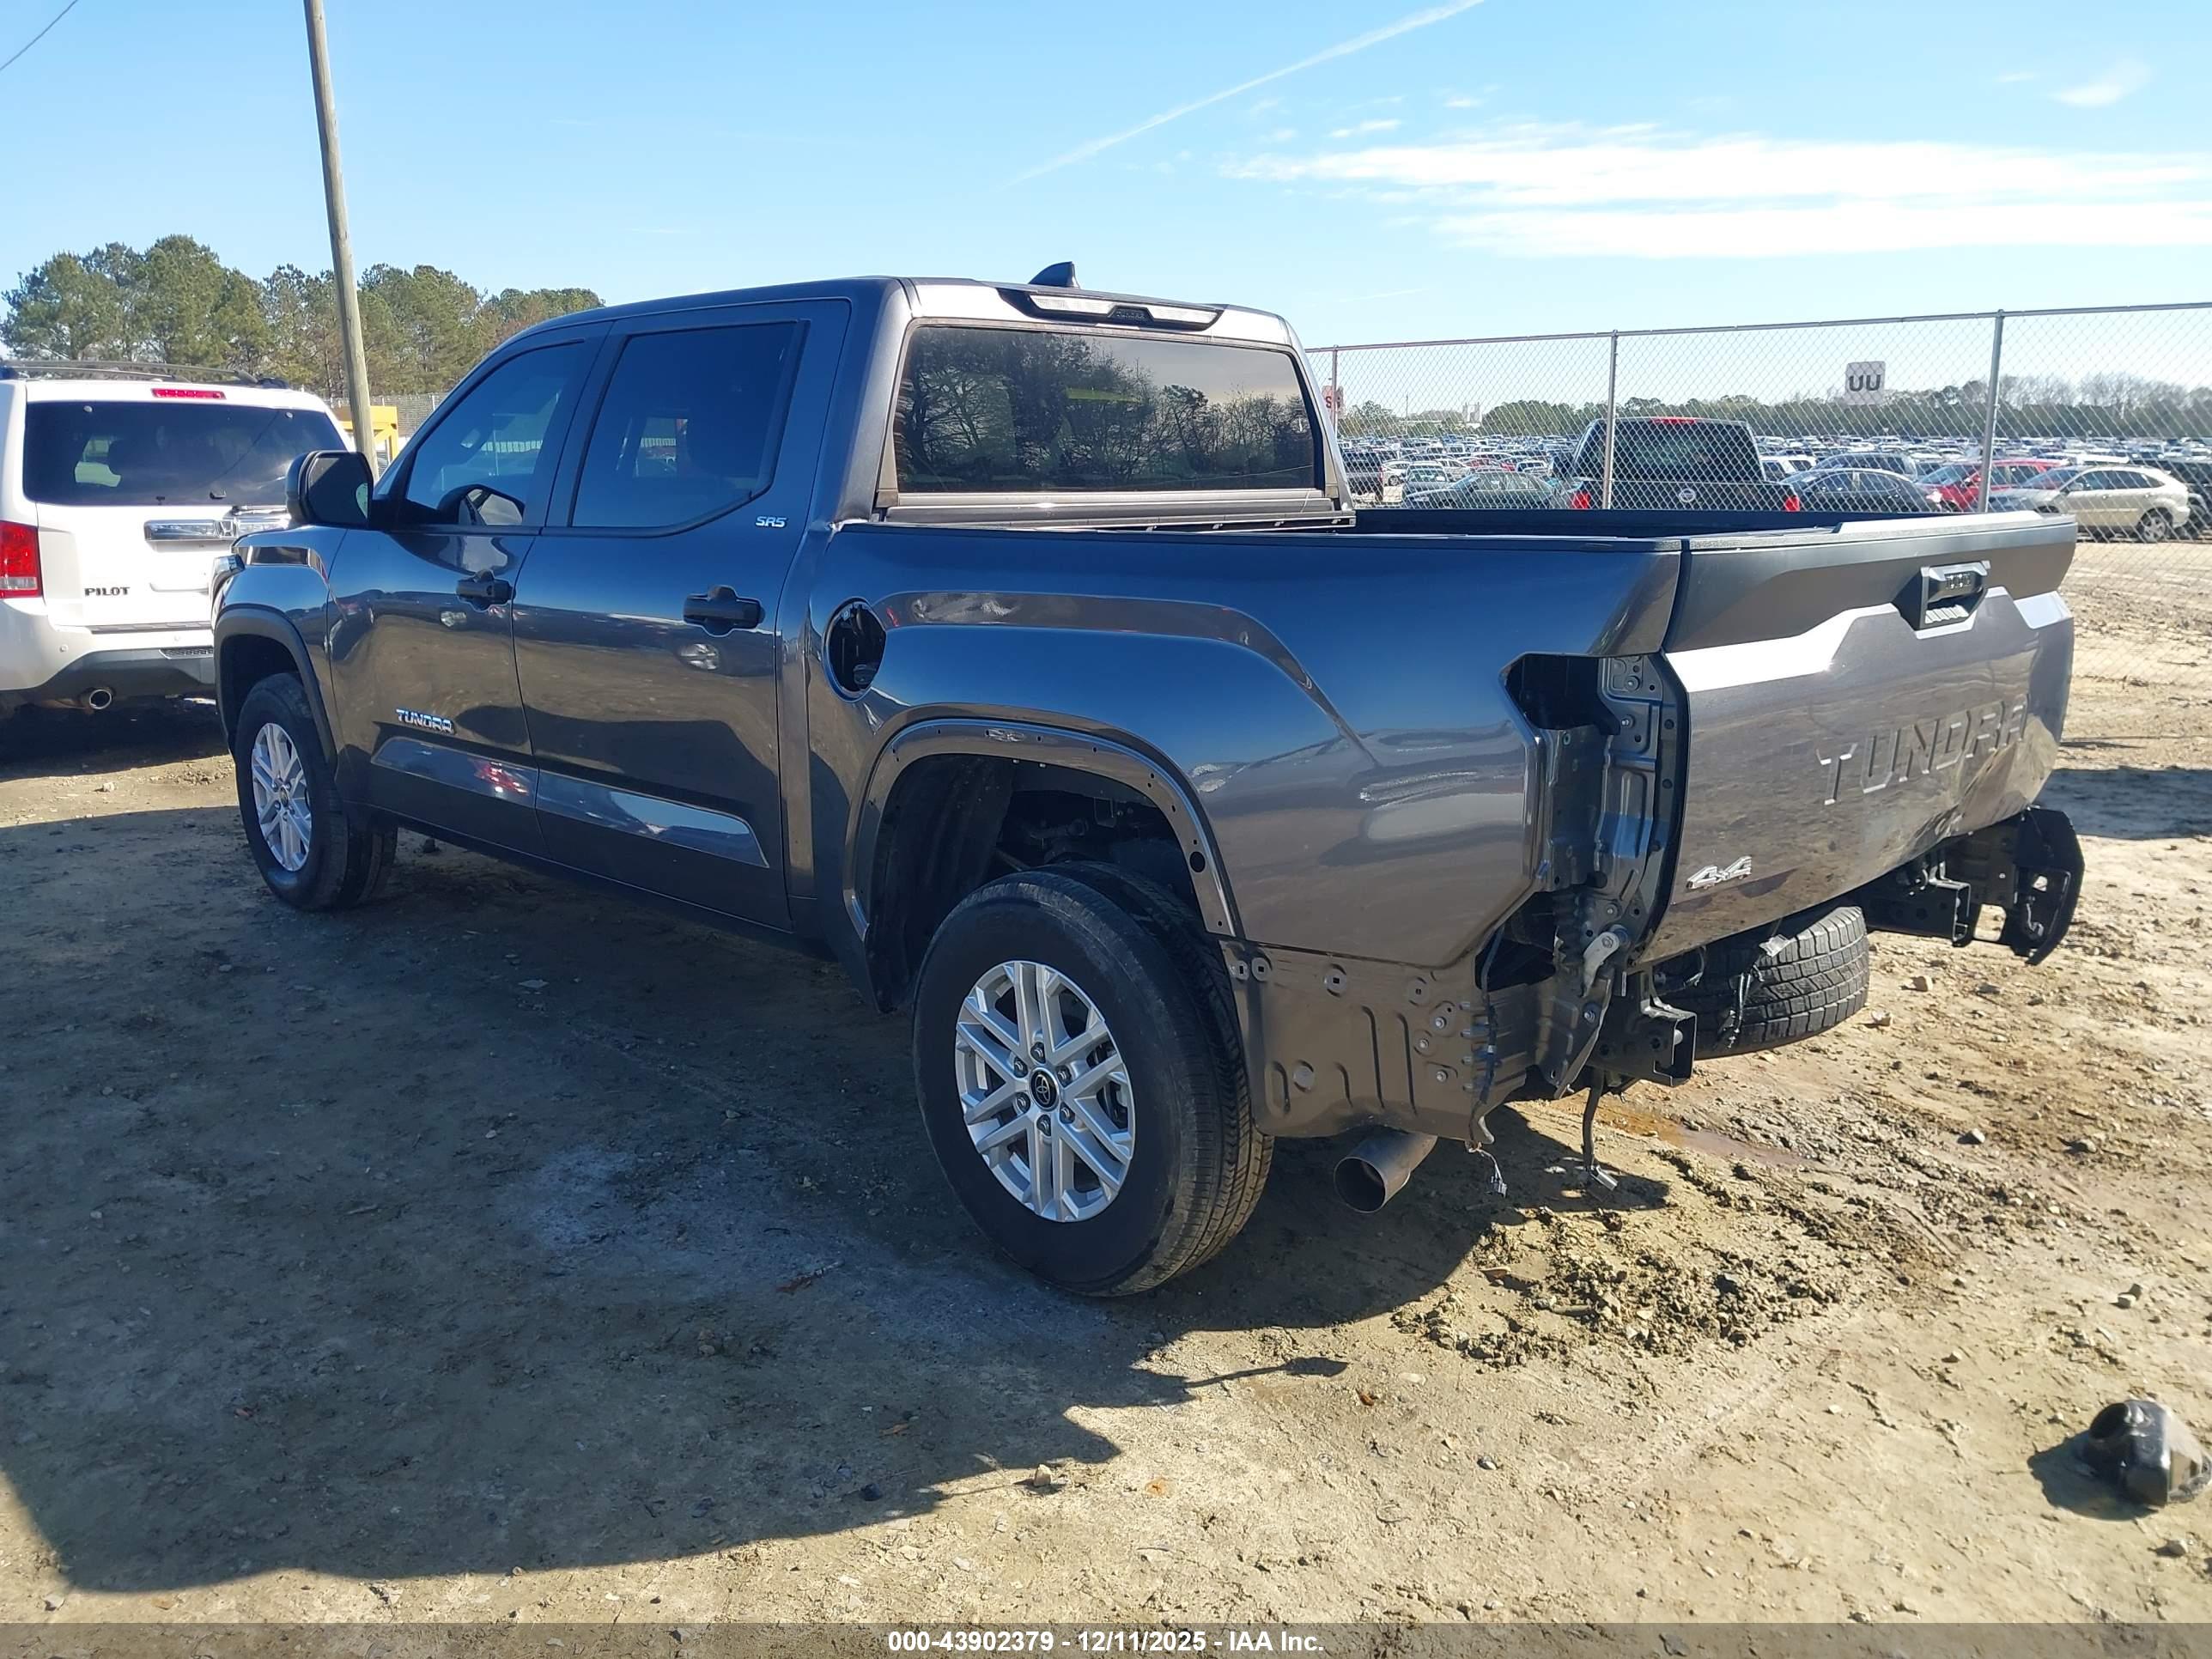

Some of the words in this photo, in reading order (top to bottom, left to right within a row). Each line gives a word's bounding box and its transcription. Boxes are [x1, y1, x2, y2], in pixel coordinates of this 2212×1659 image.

[1849, 374, 1881, 392] UU
[756, 516, 787, 527] SR5
[84, 586, 131, 597] PILOT
[396, 708, 454, 734] TUNDRA
[1815, 694, 2030, 805] TUNDRA
